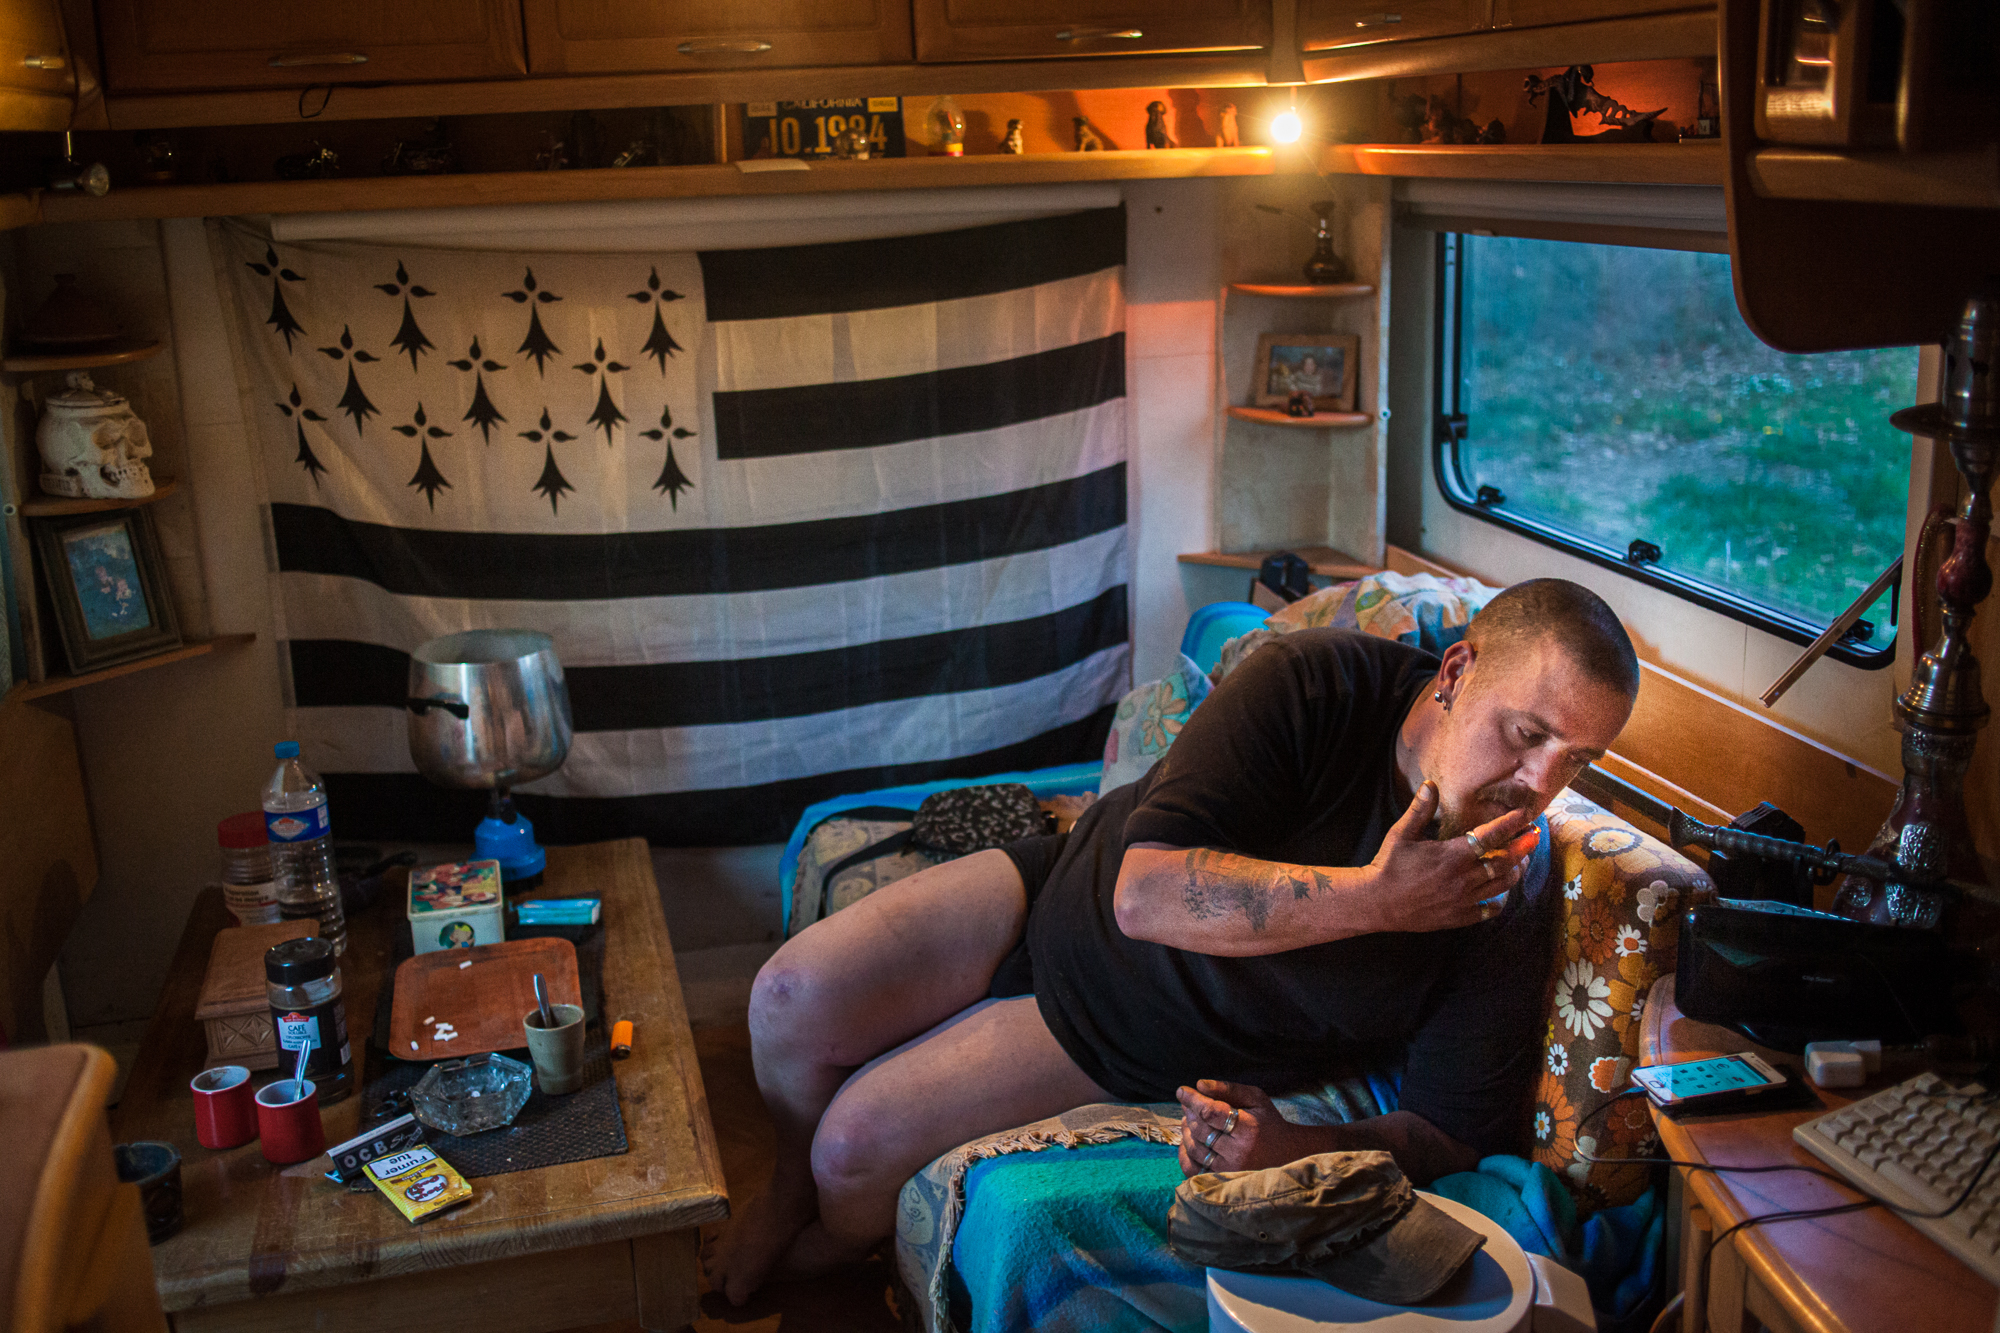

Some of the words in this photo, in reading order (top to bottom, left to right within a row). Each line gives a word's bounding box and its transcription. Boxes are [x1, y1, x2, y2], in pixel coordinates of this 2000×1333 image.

[343, 1140, 388, 1169] OCB
[389, 1153, 412, 1165] tue
[386, 1155, 428, 1176] Fumer
